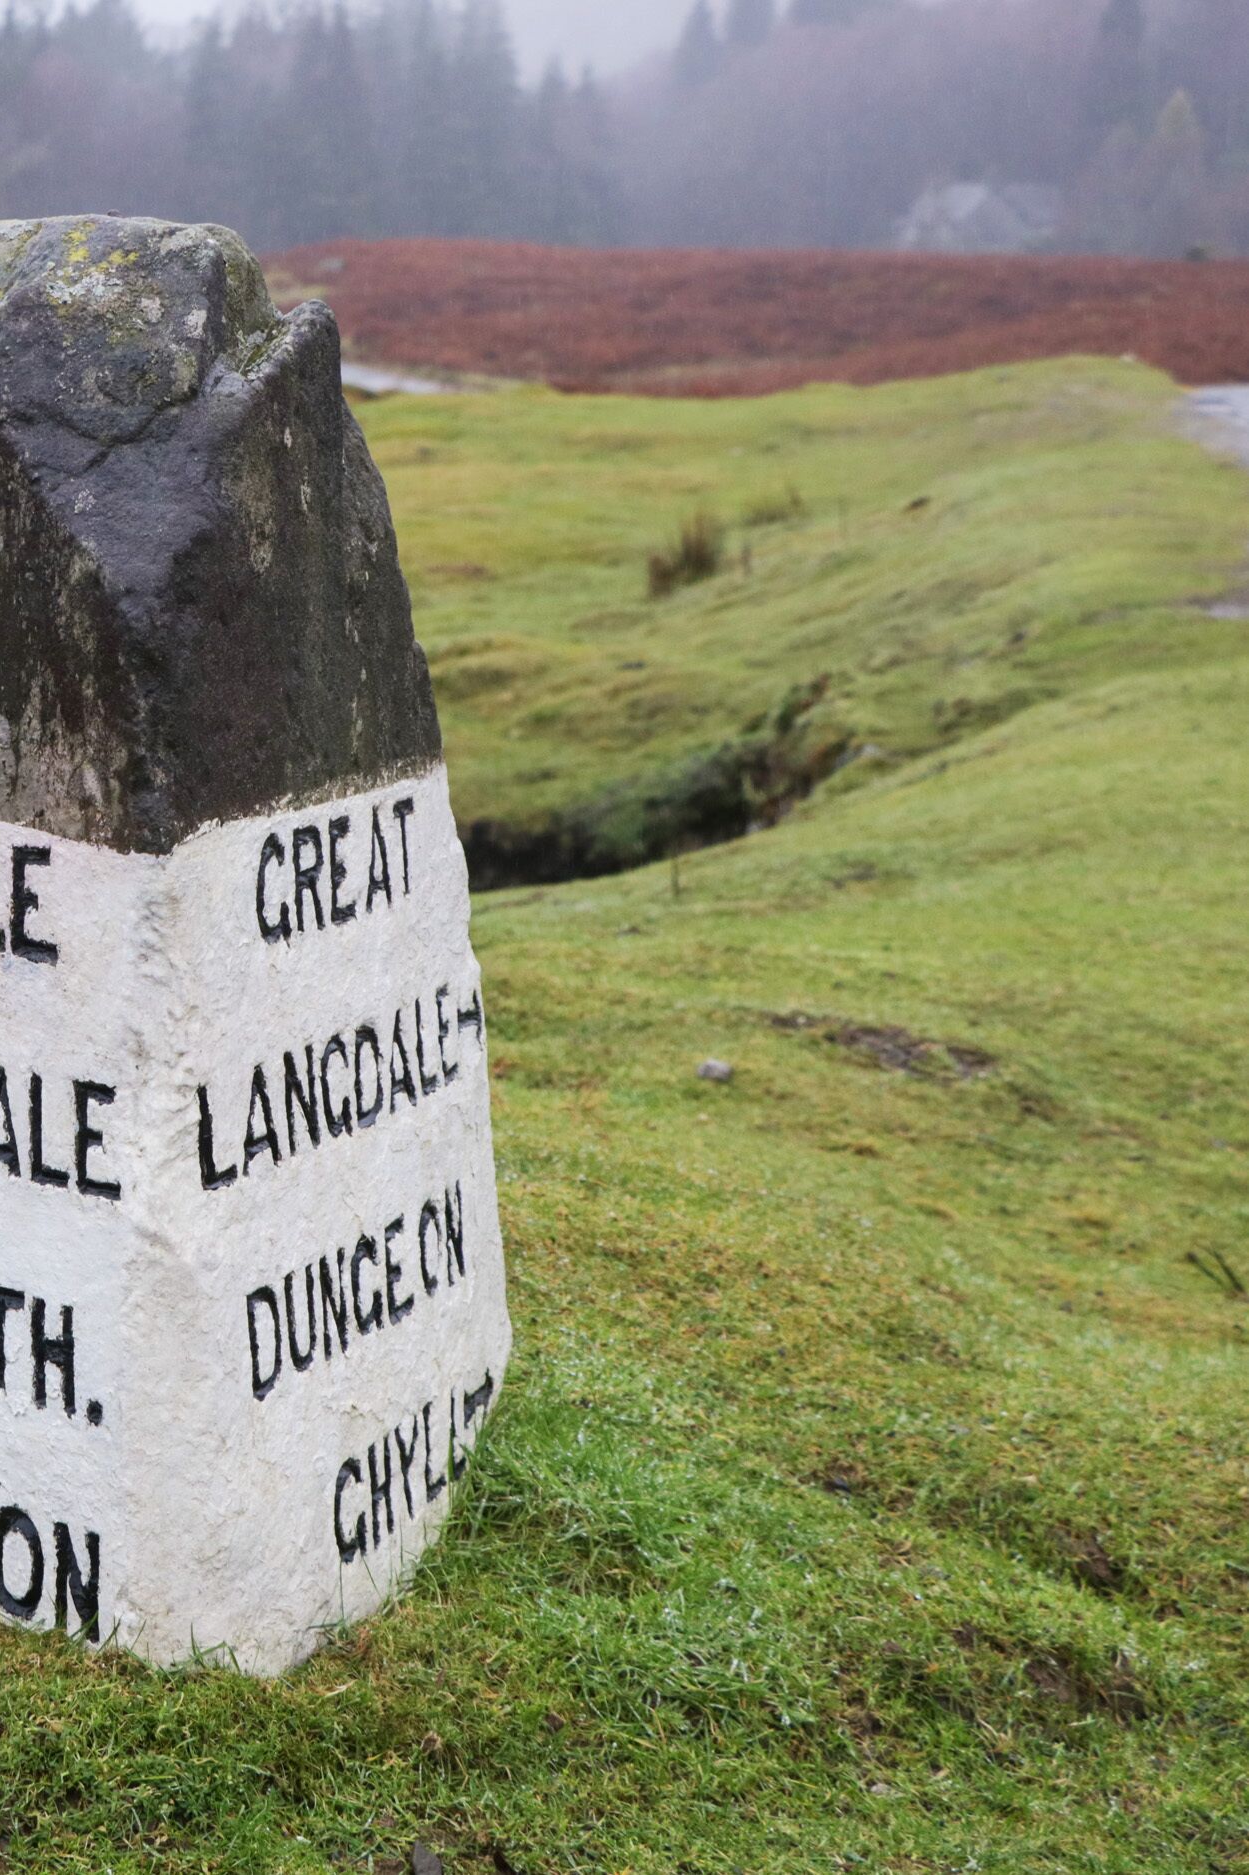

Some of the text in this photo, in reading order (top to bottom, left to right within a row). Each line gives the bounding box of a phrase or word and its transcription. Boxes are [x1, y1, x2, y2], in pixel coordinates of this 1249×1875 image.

[256, 797, 414, 947] GREAT
[197, 984, 459, 1191] LANGDALE
[247, 1179, 465, 1401] DUNGEON
[334, 1386, 466, 1563] GHYLL
